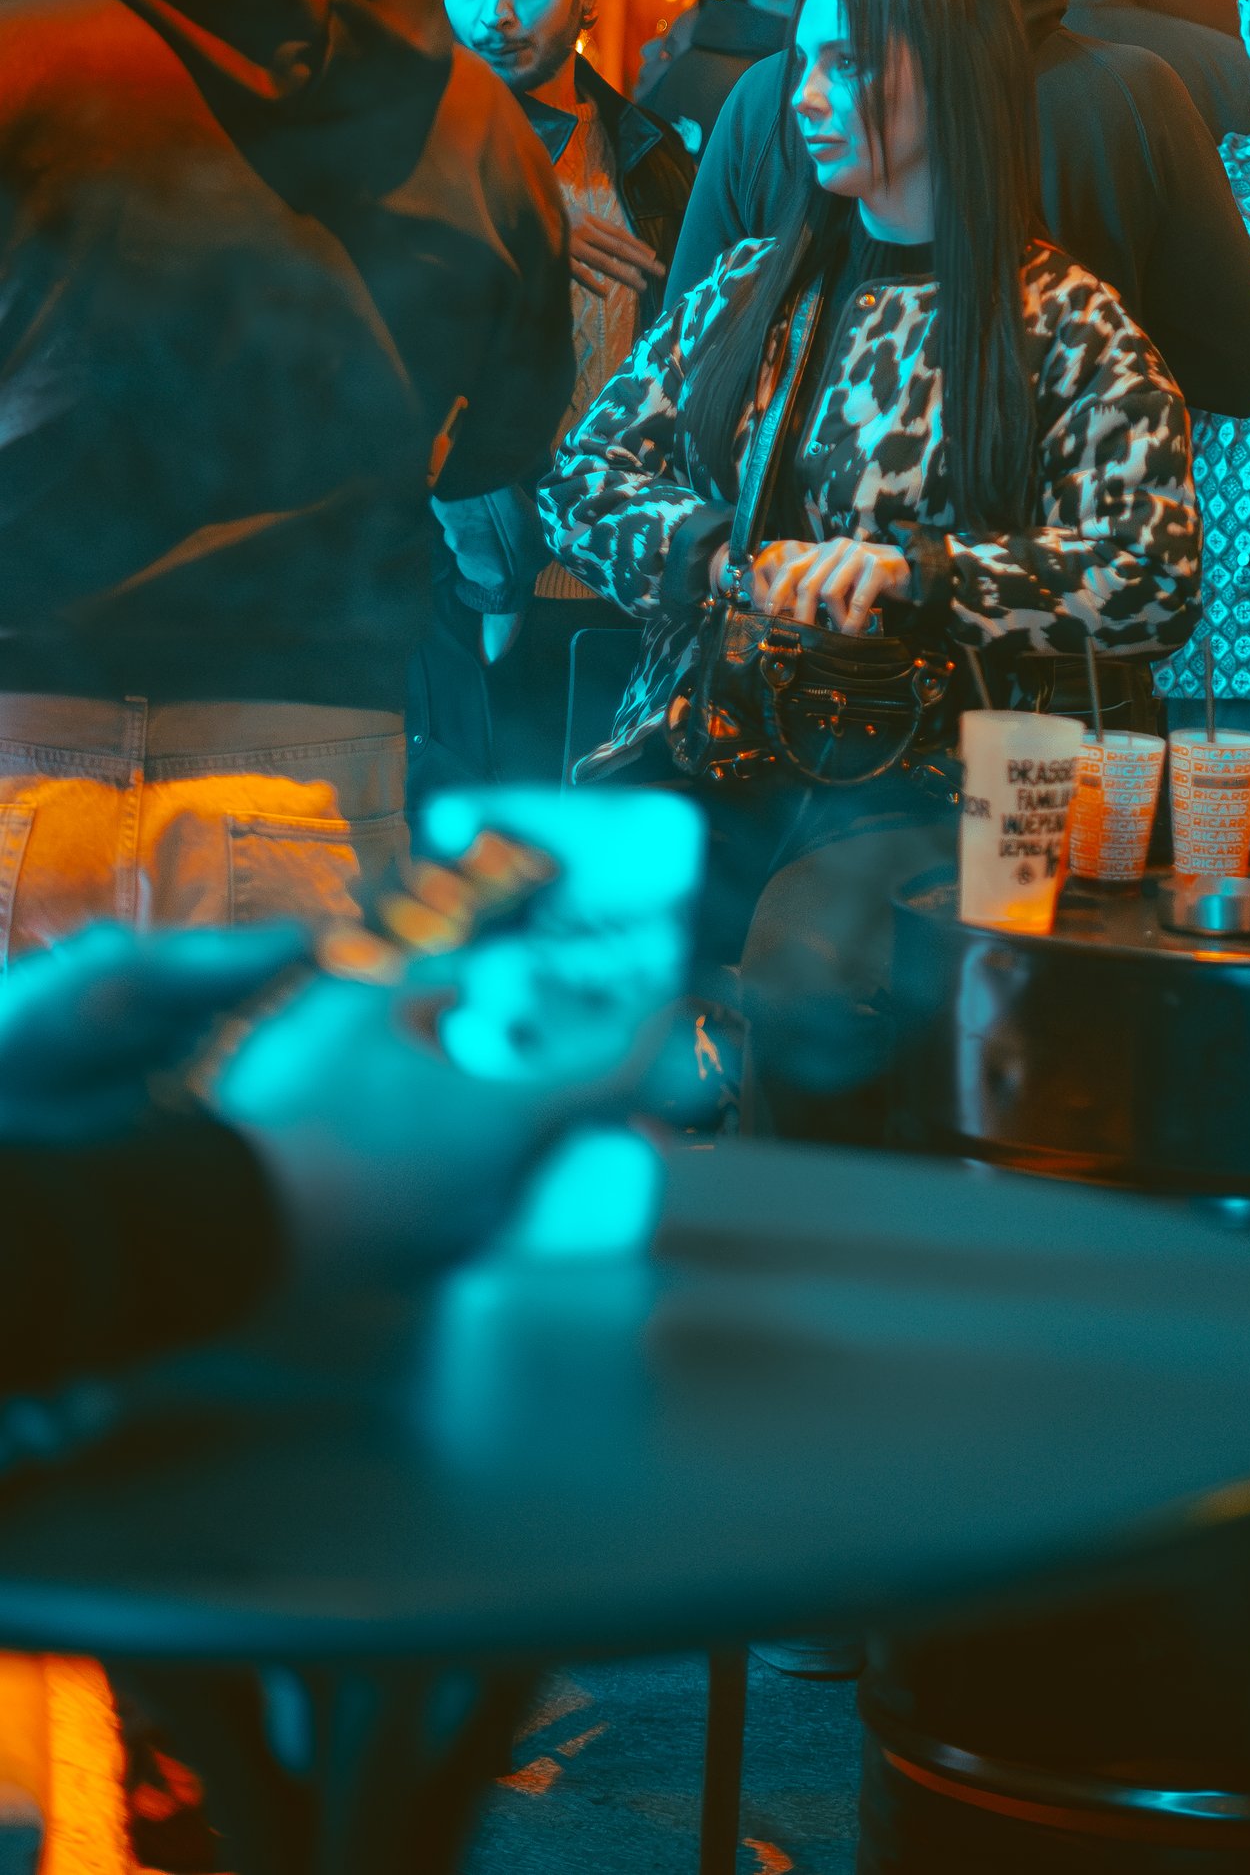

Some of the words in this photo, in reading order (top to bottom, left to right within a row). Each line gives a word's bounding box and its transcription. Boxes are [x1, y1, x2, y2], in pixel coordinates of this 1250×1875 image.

[1193, 790, 1250, 801] RICARD
[1191, 802, 1247, 814] RICARD
[1192, 817, 1248, 828] RICARD
[1192, 844, 1242, 855] RICARD
